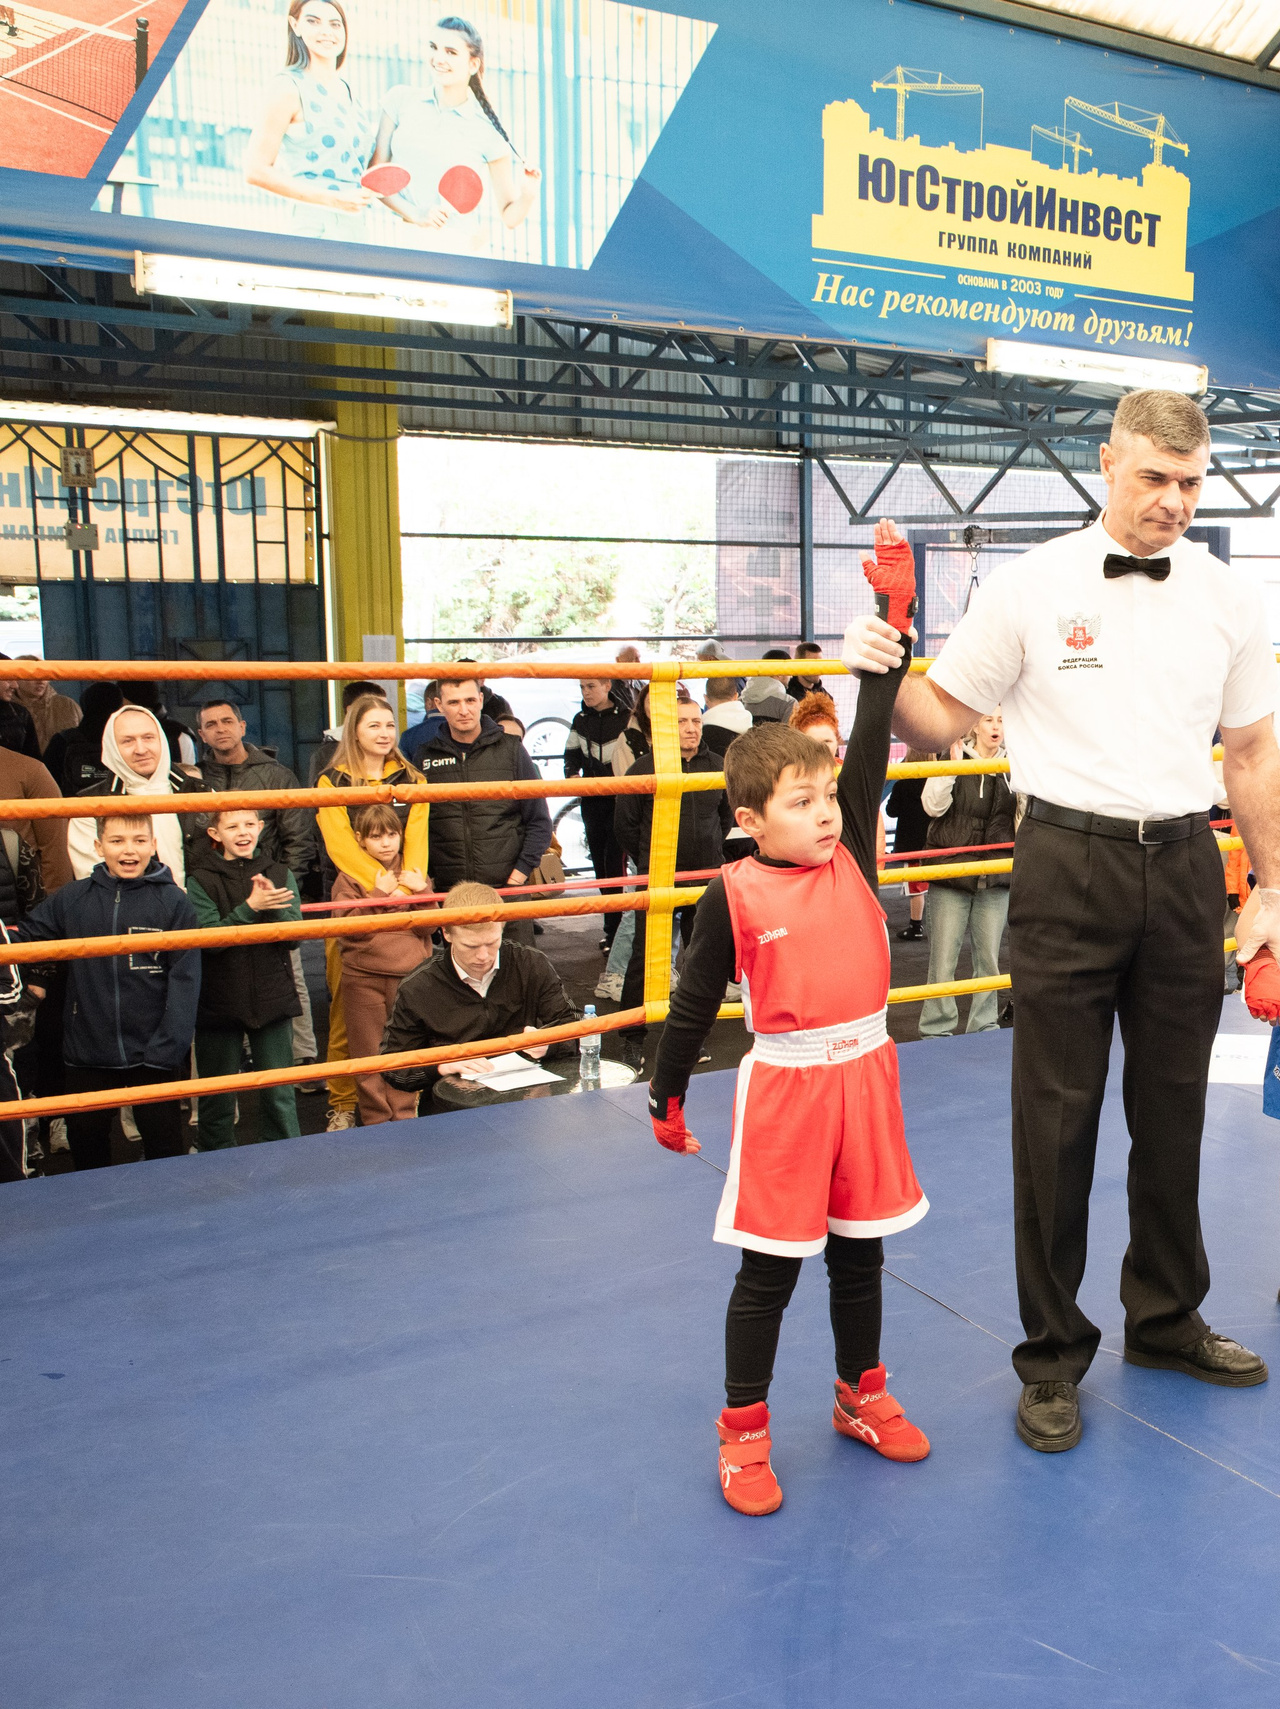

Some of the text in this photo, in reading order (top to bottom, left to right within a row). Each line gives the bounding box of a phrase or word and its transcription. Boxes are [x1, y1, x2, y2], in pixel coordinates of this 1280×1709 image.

[857, 153, 1162, 248] ЮгСтройИнвест
[938, 231, 1093, 270] ГРУППА КОМПАНИЙ
[957, 273, 999, 290] ОСНОВАНА
[1010, 278, 1042, 296] 2003
[811, 272, 1194, 348] Нас рекомендуют друзьям!
[431, 757, 457, 767] СИТИ
